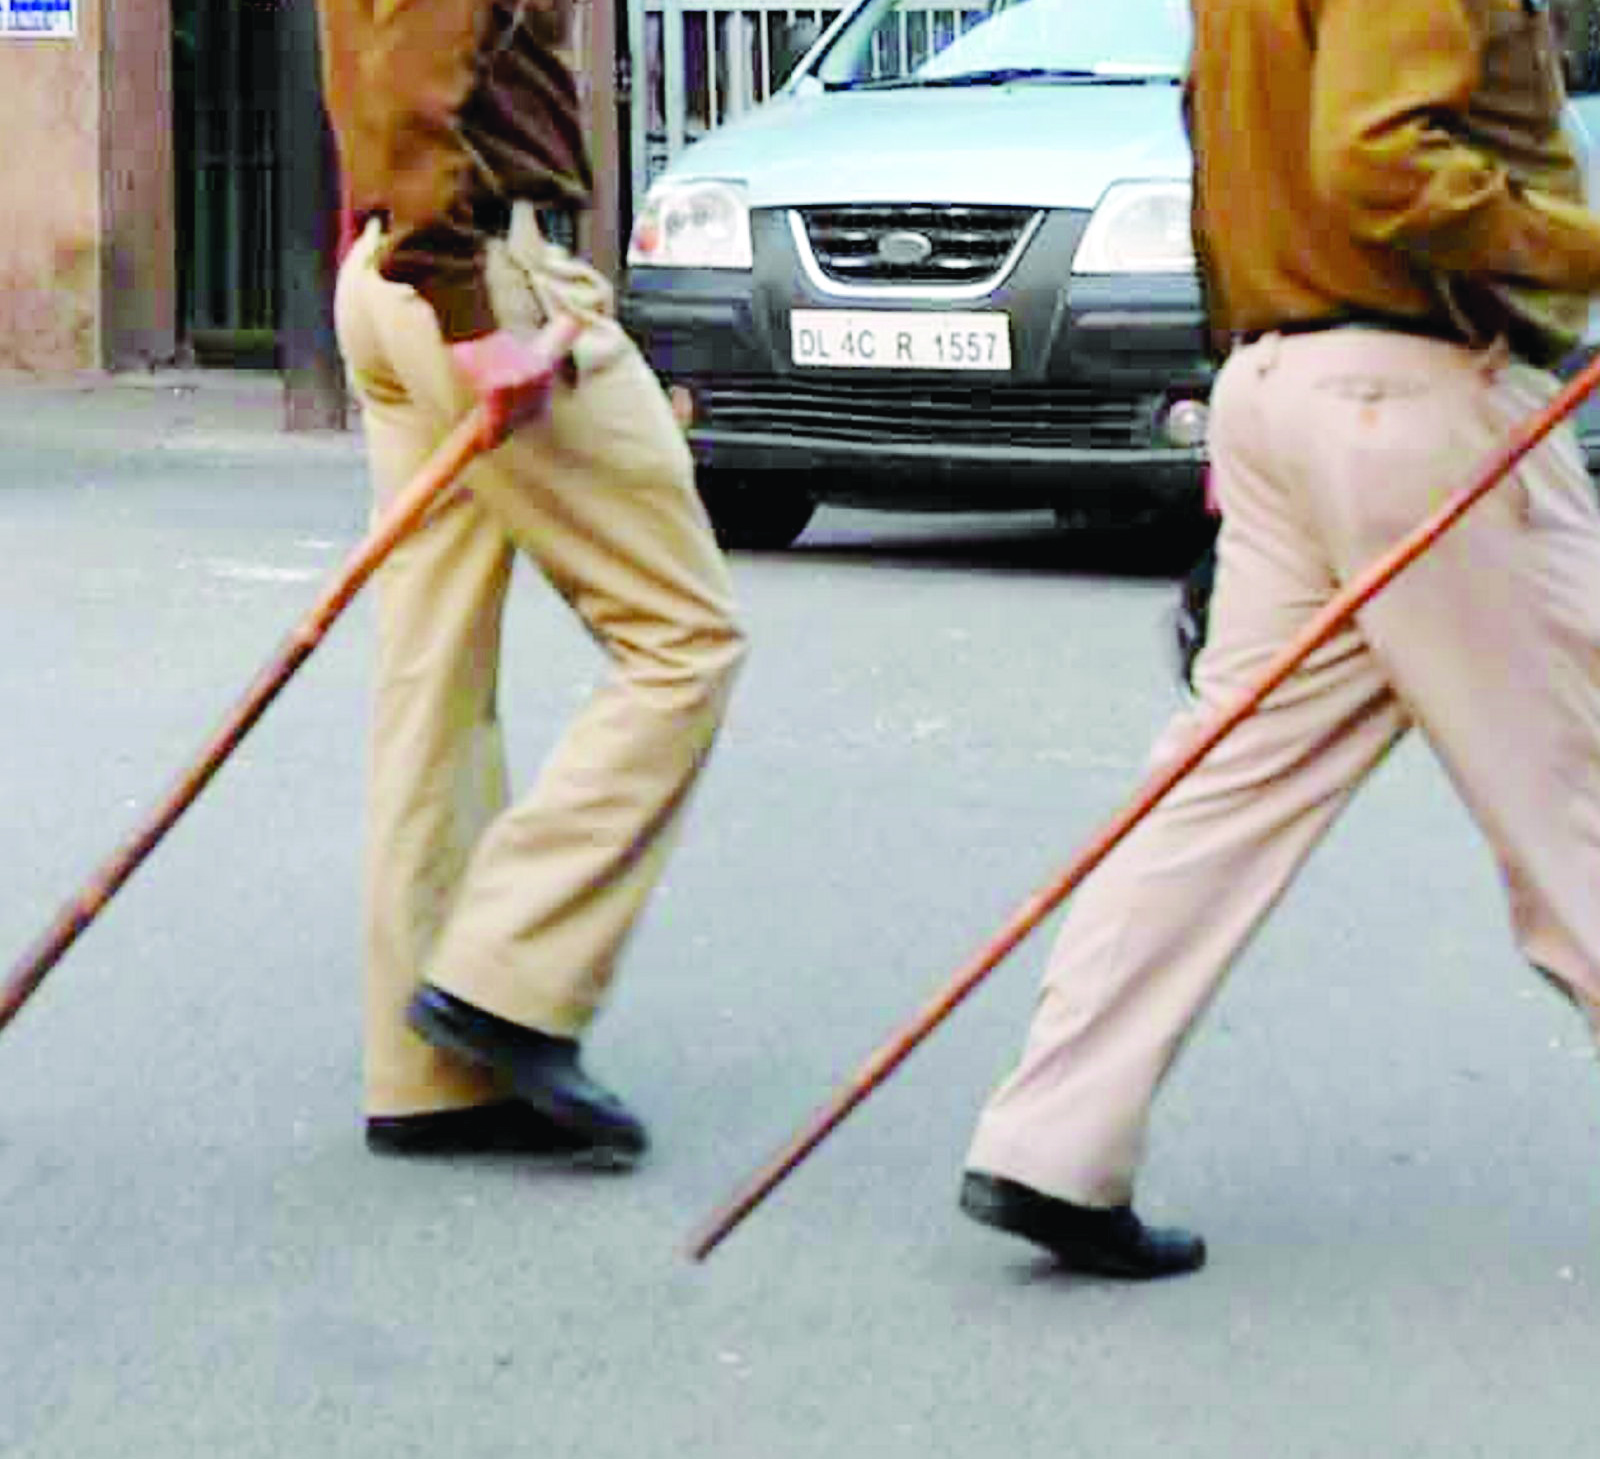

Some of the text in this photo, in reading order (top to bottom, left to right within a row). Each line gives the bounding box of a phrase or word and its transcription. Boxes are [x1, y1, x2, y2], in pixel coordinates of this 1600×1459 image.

[799, 329, 997, 362] DL 4C R 1557
